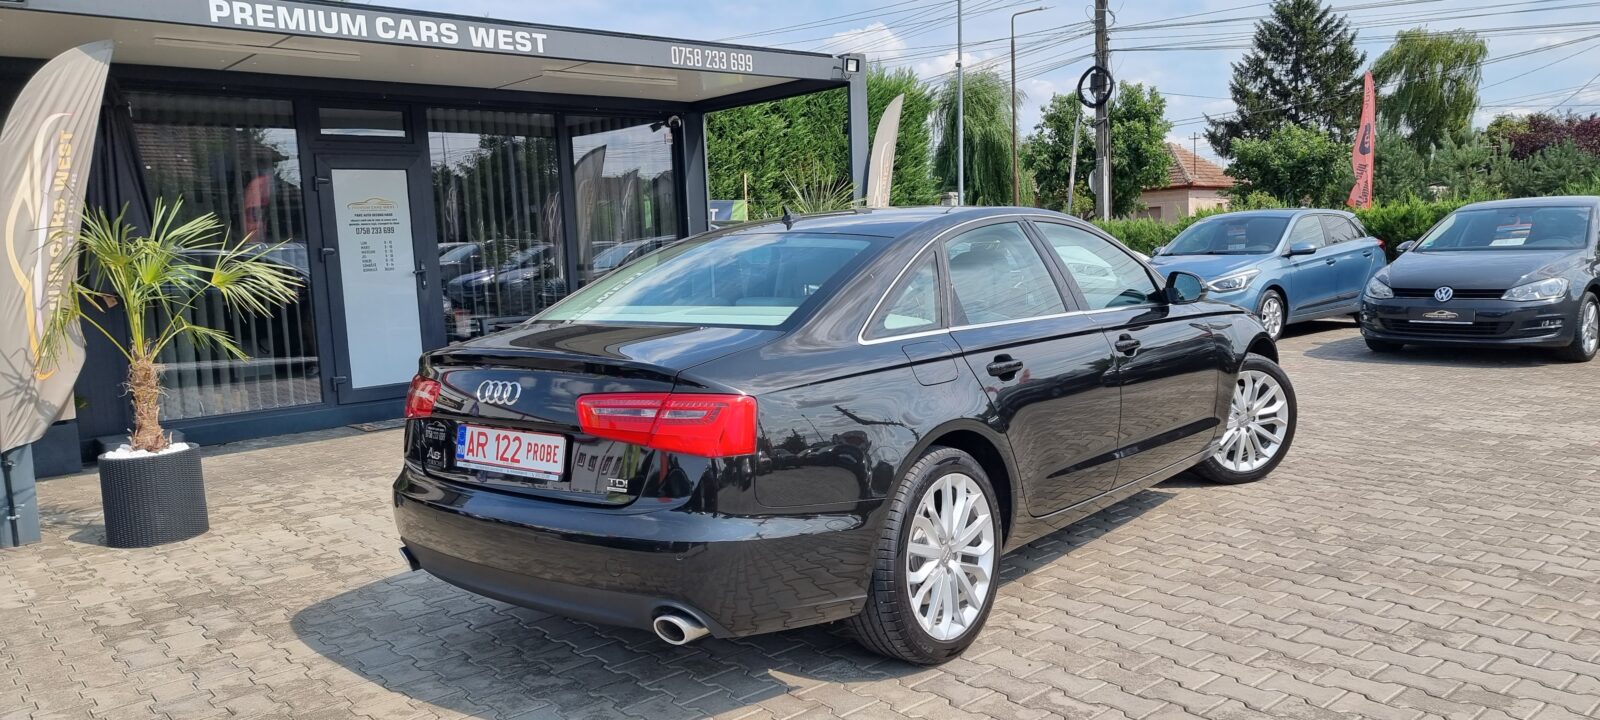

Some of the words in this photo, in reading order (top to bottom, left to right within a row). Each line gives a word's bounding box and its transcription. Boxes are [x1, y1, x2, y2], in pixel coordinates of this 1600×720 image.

[208, 0, 367, 37] PREMIUM
[375, 16, 459, 45] CARS
[469, 26, 548, 53] WEST
[671, 46, 702, 67] 0758
[705, 49, 727, 69] 233
[730, 52, 753, 72] 699
[53, 130, 73, 192] WEST
[48, 198, 66, 258] CARS
[355, 227, 371, 235] 0758
[371, 227, 382, 235] 233
[466, 431, 488, 459] AR
[495, 434, 522, 464] 122
[526, 442, 560, 464] PROBE
[607, 477, 629, 488] TDI
